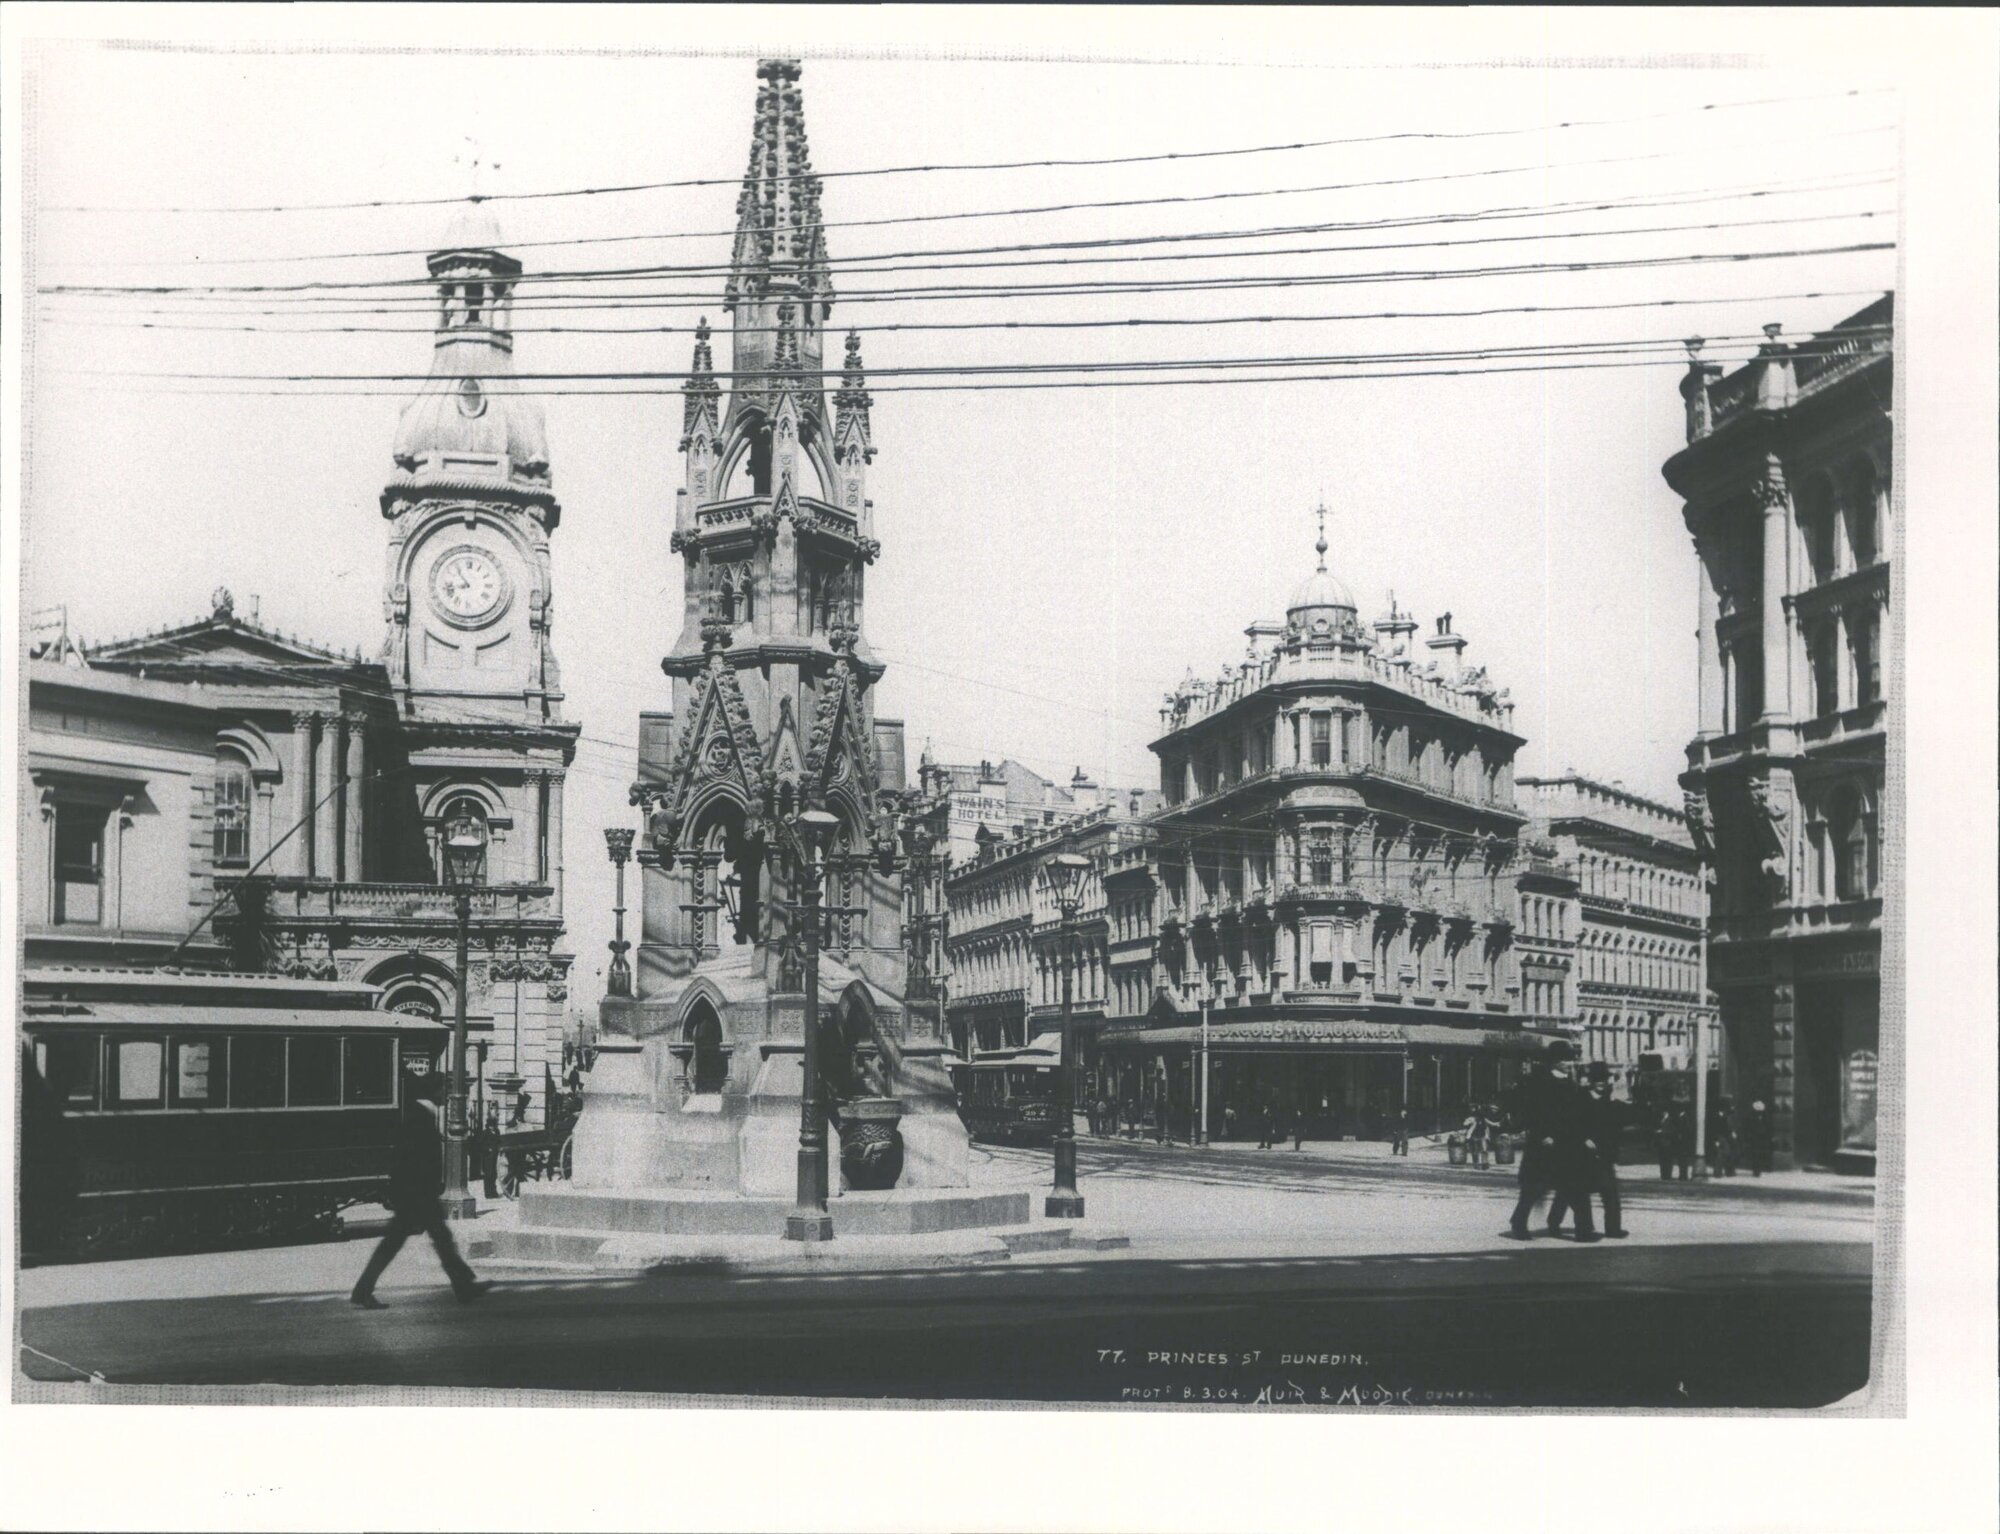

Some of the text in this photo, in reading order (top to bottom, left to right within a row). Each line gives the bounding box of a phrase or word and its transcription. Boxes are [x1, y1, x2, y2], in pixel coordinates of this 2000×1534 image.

[958, 810, 1002, 819] HOTEL
[1219, 1024, 1284, 1038] JACOBS
[1294, 1022, 1405, 1039] TOBACCONIST
